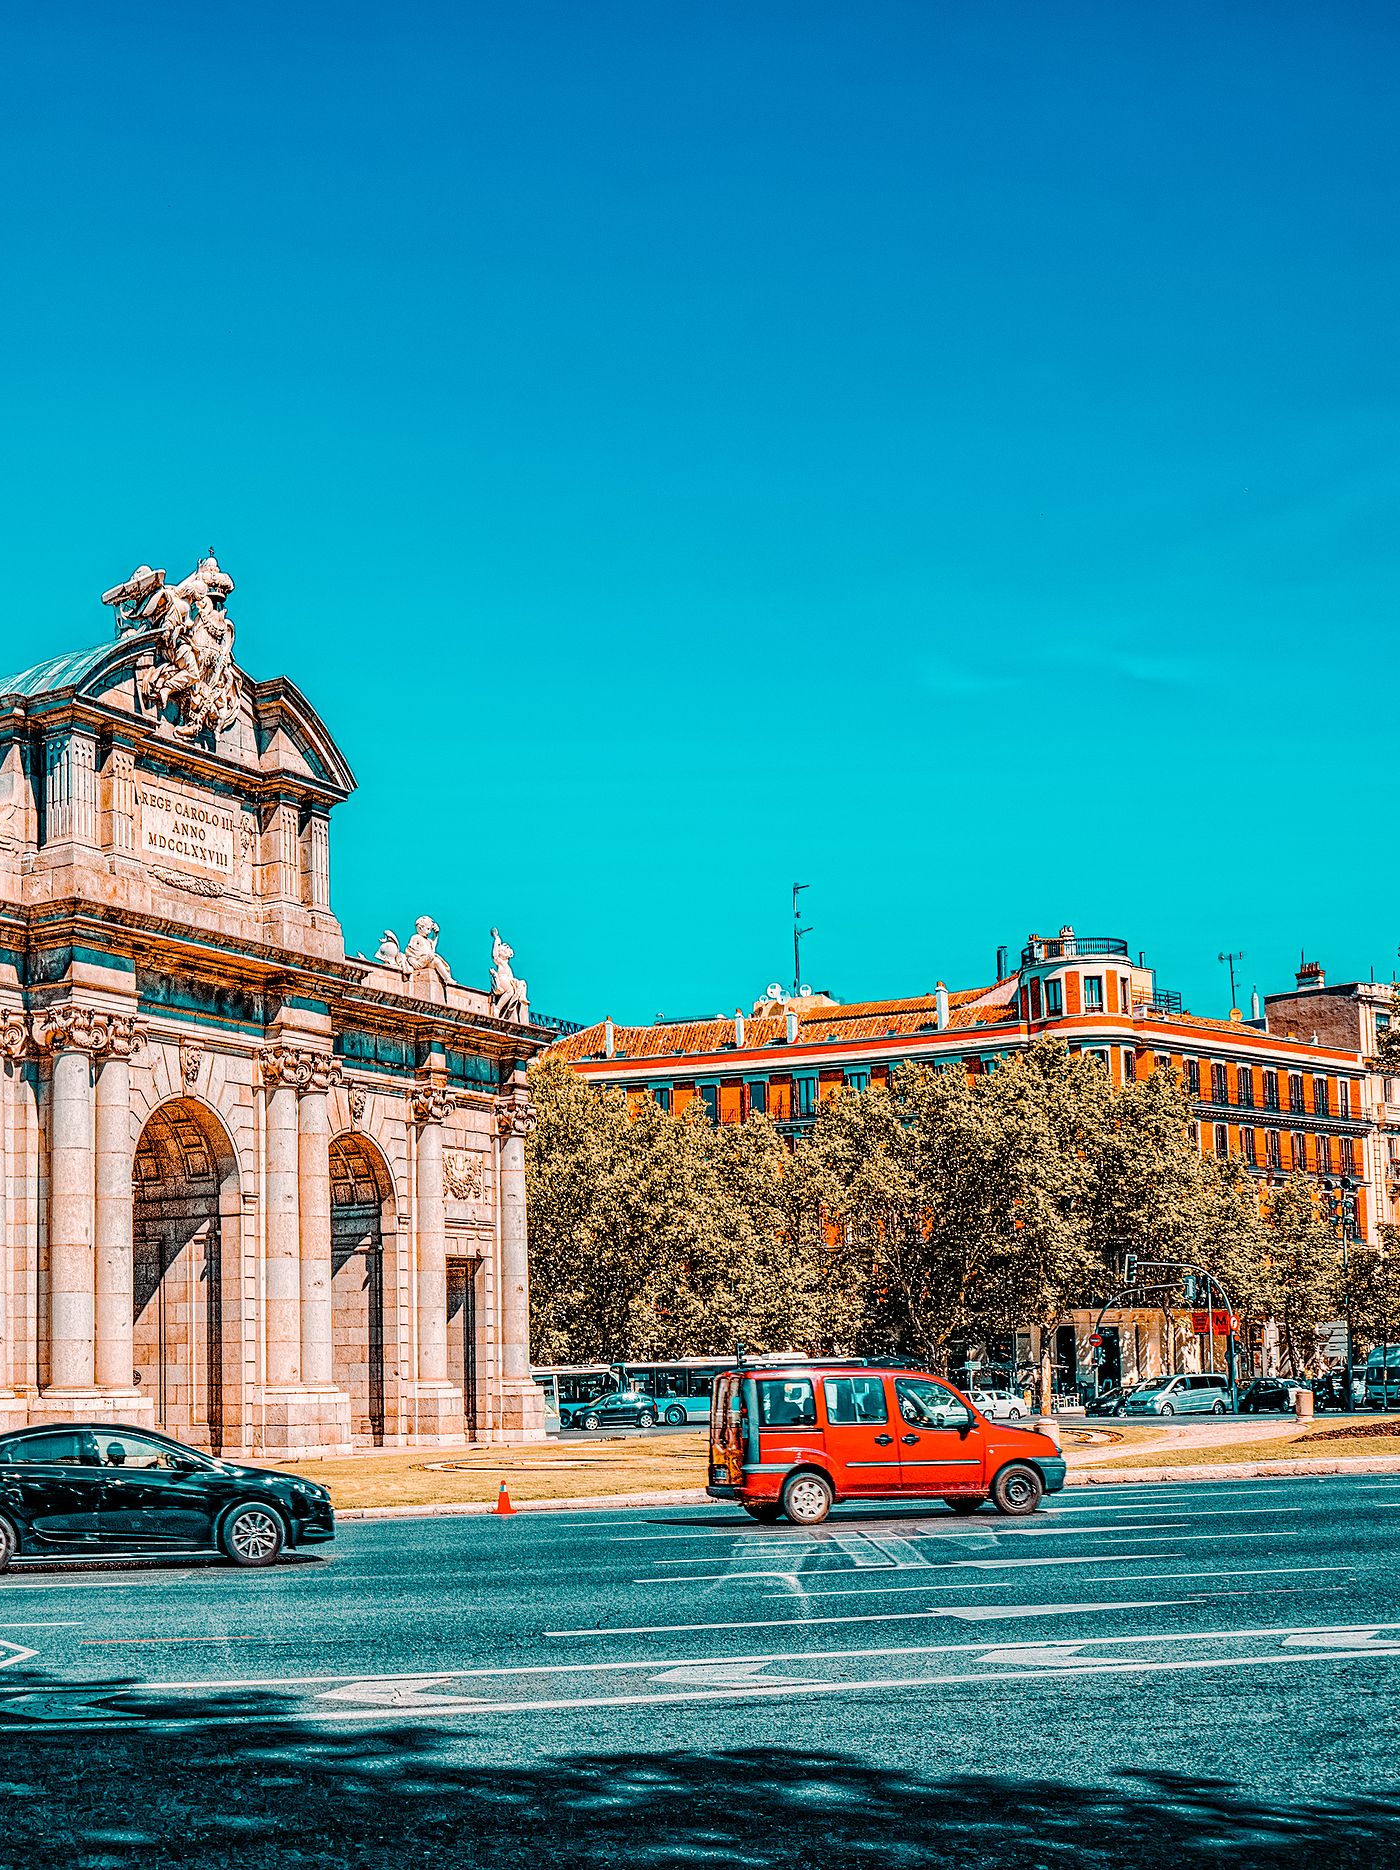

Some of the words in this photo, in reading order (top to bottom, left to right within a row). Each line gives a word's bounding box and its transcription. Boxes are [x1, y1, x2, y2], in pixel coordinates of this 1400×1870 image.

[141, 792, 171, 811] REGE
[175, 802, 219, 827] CAROLO
[222, 817, 233, 831] III
[172, 820, 206, 841] ANNO
[148, 832, 227, 866] MDCCLXXVIII
